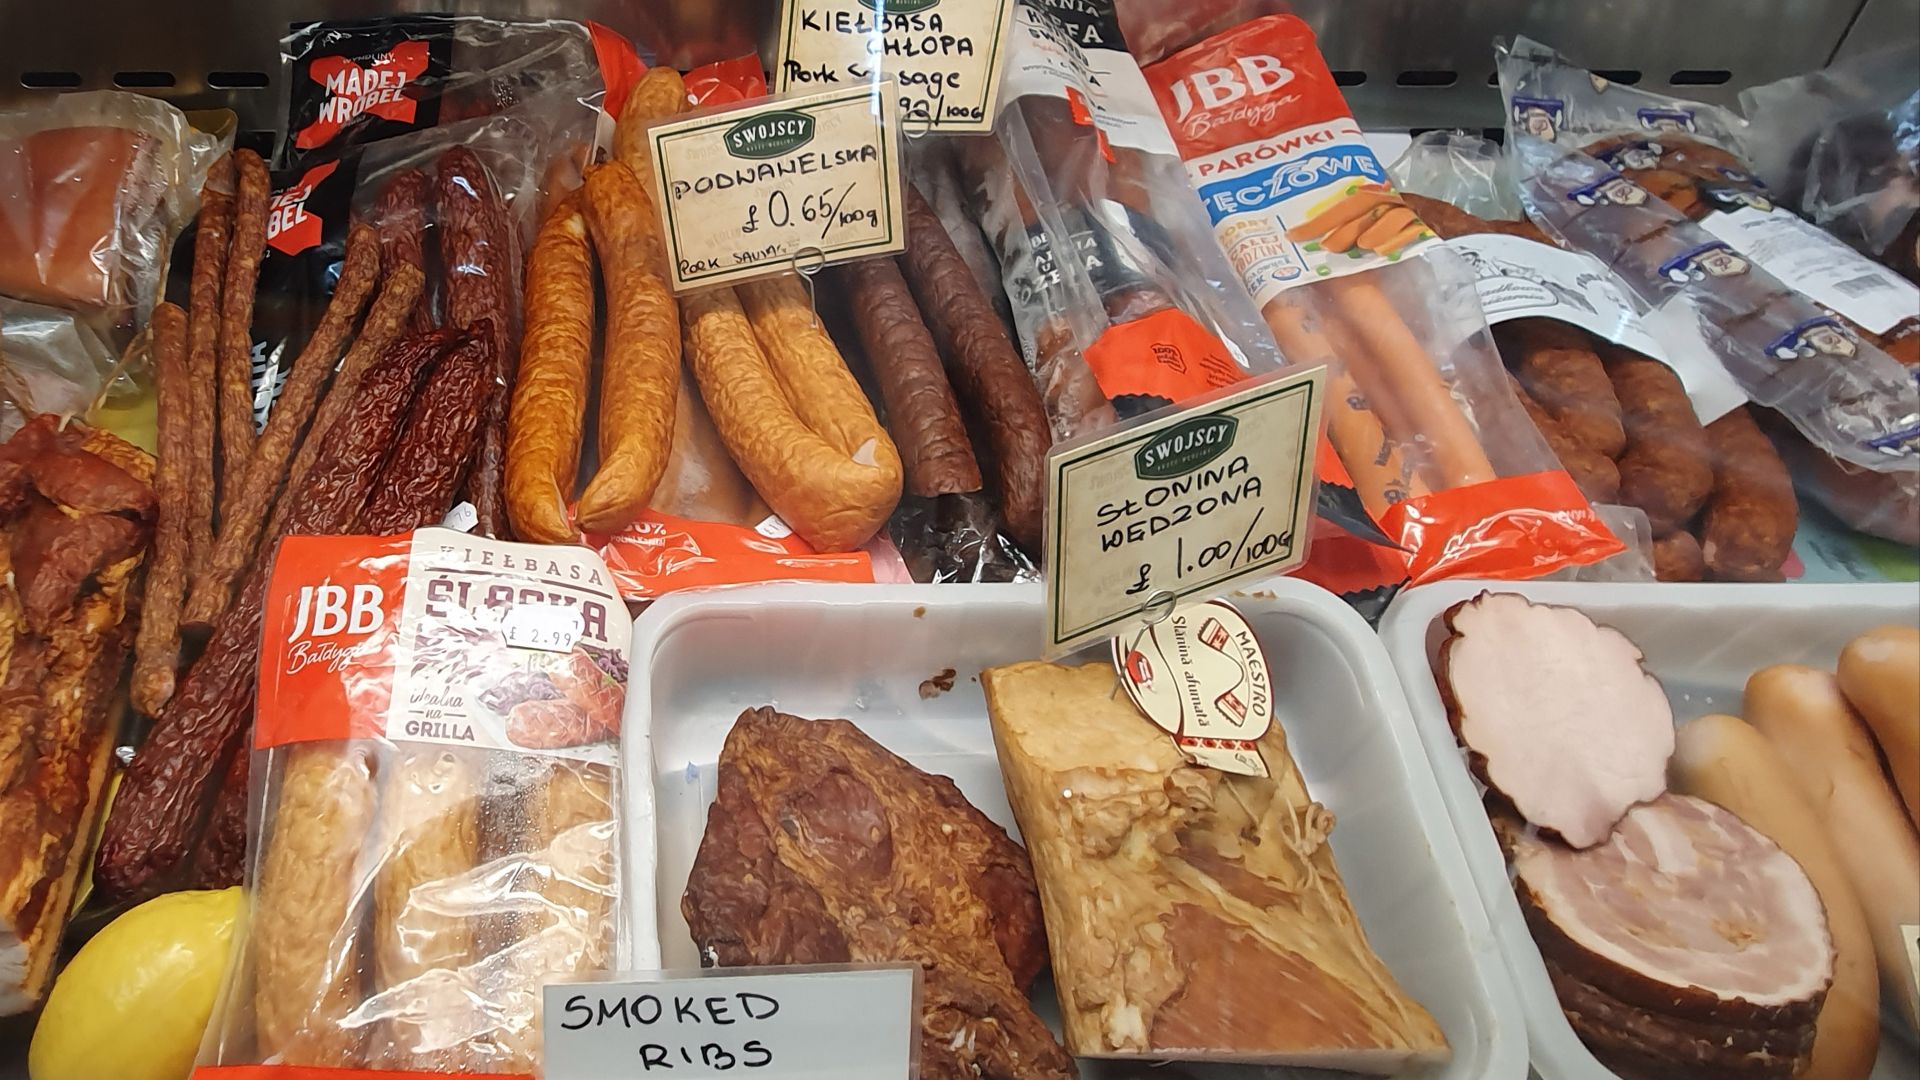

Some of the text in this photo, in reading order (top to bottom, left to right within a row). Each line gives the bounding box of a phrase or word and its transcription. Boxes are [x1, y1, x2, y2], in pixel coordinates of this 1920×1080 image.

[802, 10, 943, 34] KIEŁBASA
[866, 35, 974, 57] CHŁOPA
[325, 67, 407, 97] MADEJ
[784, 60, 839, 84] Pork
[1171, 55, 1296, 124] JBB
[732, 119, 807, 149] SWOJSCY
[1183, 94, 1303, 141] Bałdyga
[1198, 129, 1336, 177] PARÓWKI
[671, 144, 879, 200] PODWAWELSKA
[1203, 154, 1379, 214] ĘCZOWE
[1144, 424, 1229, 468] SWOJSCY
[1097, 455, 1249, 528] SŁONINA
[1126, 563, 1152, 596] £
[287, 583, 385, 644] JBB
[509, 626, 572, 647] £ 2.99
[1235, 631, 1267, 718] MAESTRO
[405, 720, 476, 742] GRILLA
[425, 709, 442, 719] na
[560, 992, 781, 1030] SMOKED
[639, 1040, 773, 1071] RIBS
